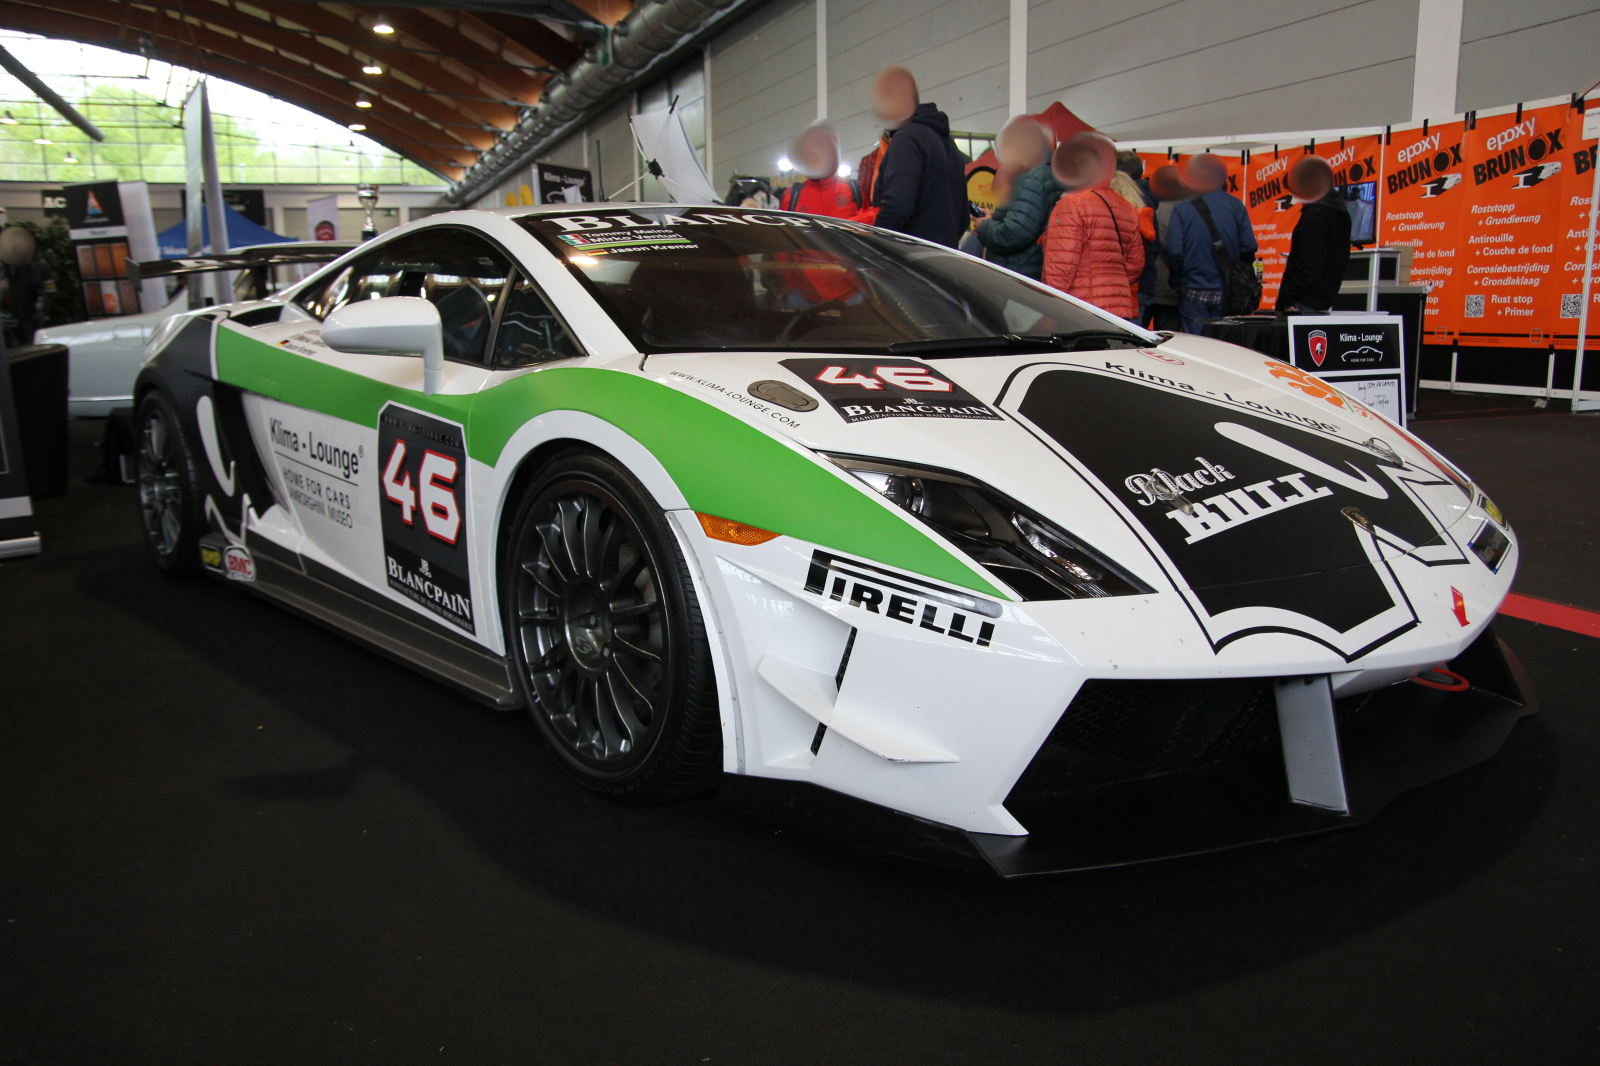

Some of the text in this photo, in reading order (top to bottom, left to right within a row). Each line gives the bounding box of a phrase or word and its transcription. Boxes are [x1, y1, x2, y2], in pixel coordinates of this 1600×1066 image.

[1487, 116, 1537, 151] epoxy
[1397, 132, 1441, 163] epoxy
[1473, 128, 1565, 187] BRUNOX
[1255, 156, 1288, 181] epoxy
[1387, 143, 1464, 195] BRUNOX
[1249, 173, 1289, 209] BRUN
[1471, 204, 1515, 214] Roststopp
[1386, 211, 1424, 222] Roststopp
[1485, 214, 1541, 226] Grundierung
[1252, 223, 1277, 231] oststopp
[1398, 221, 1445, 232] Grundierung
[581, 230, 631, 239] Tommy
[588, 235, 632, 243] Mirko
[1468, 233, 1514, 244] Antirouille
[610, 243, 699, 254] Jason Kremer
[1413, 248, 1455, 259] che de fond
[1483, 246, 1516, 256] Couche
[1518, 245, 1529, 254] de
[1532, 243, 1553, 254] fond
[1467, 262, 1550, 275] Corrosiebestrijding
[1482, 276, 1540, 287] Grondlaklaag
[1426, 296, 1439, 305] top
[1491, 295, 1533, 305] Rust stop
[1505, 307, 1534, 316] Primer
[1339, 333, 1357, 342] Klima
[815, 366, 953, 392] 46
[1105, 361, 1195, 392] Klima
[840, 404, 995, 417] BLANCPAIN
[270, 417, 299, 452] Klima
[306, 477, 322, 498] FOR
[326, 486, 351, 510] CARS
[382, 439, 461, 546] 46
[387, 555, 470, 620] BLANCPAIN
[803, 549, 1003, 648] PIRELLI
